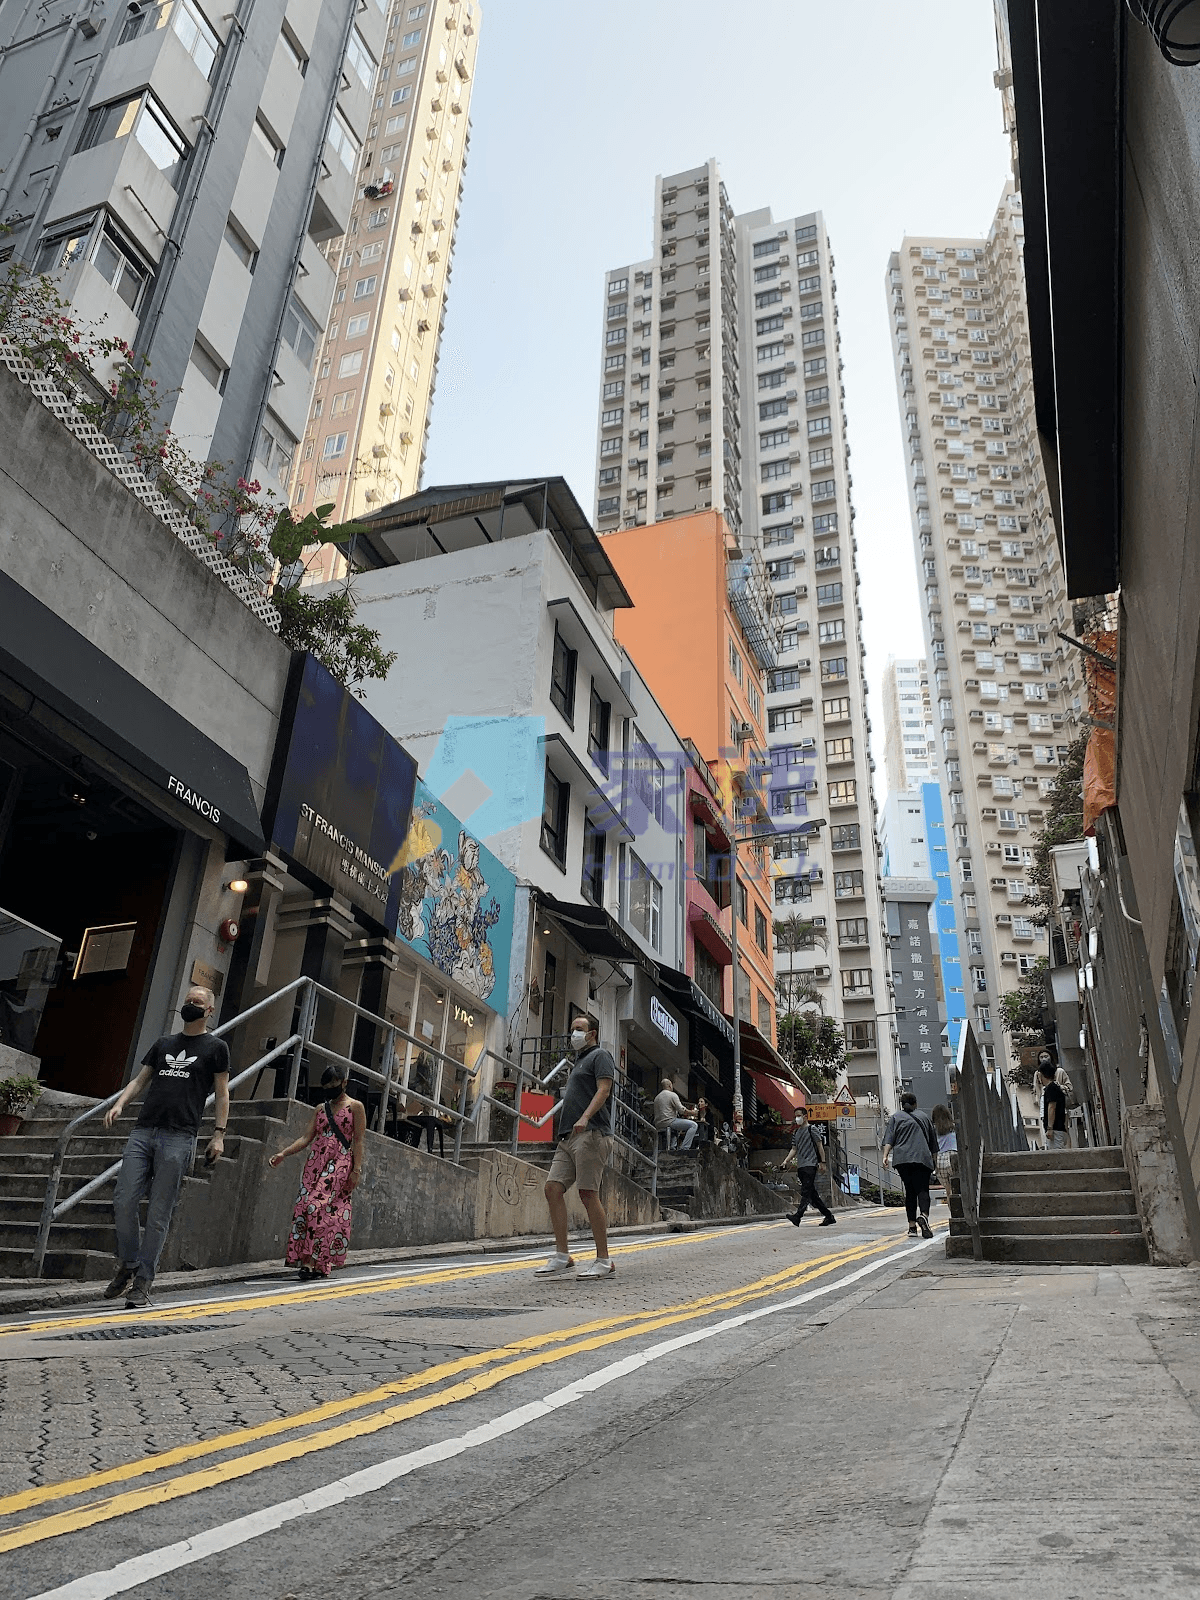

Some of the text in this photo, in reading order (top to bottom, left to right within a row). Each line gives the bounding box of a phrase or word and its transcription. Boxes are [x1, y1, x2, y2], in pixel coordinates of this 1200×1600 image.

[168, 775, 220, 823] FRANCIS
[301, 803, 392, 886] ST FRANCIS MANSION
[884, 882, 930, 892] SCHOOL
[158, 1069, 190, 1079] adidas
